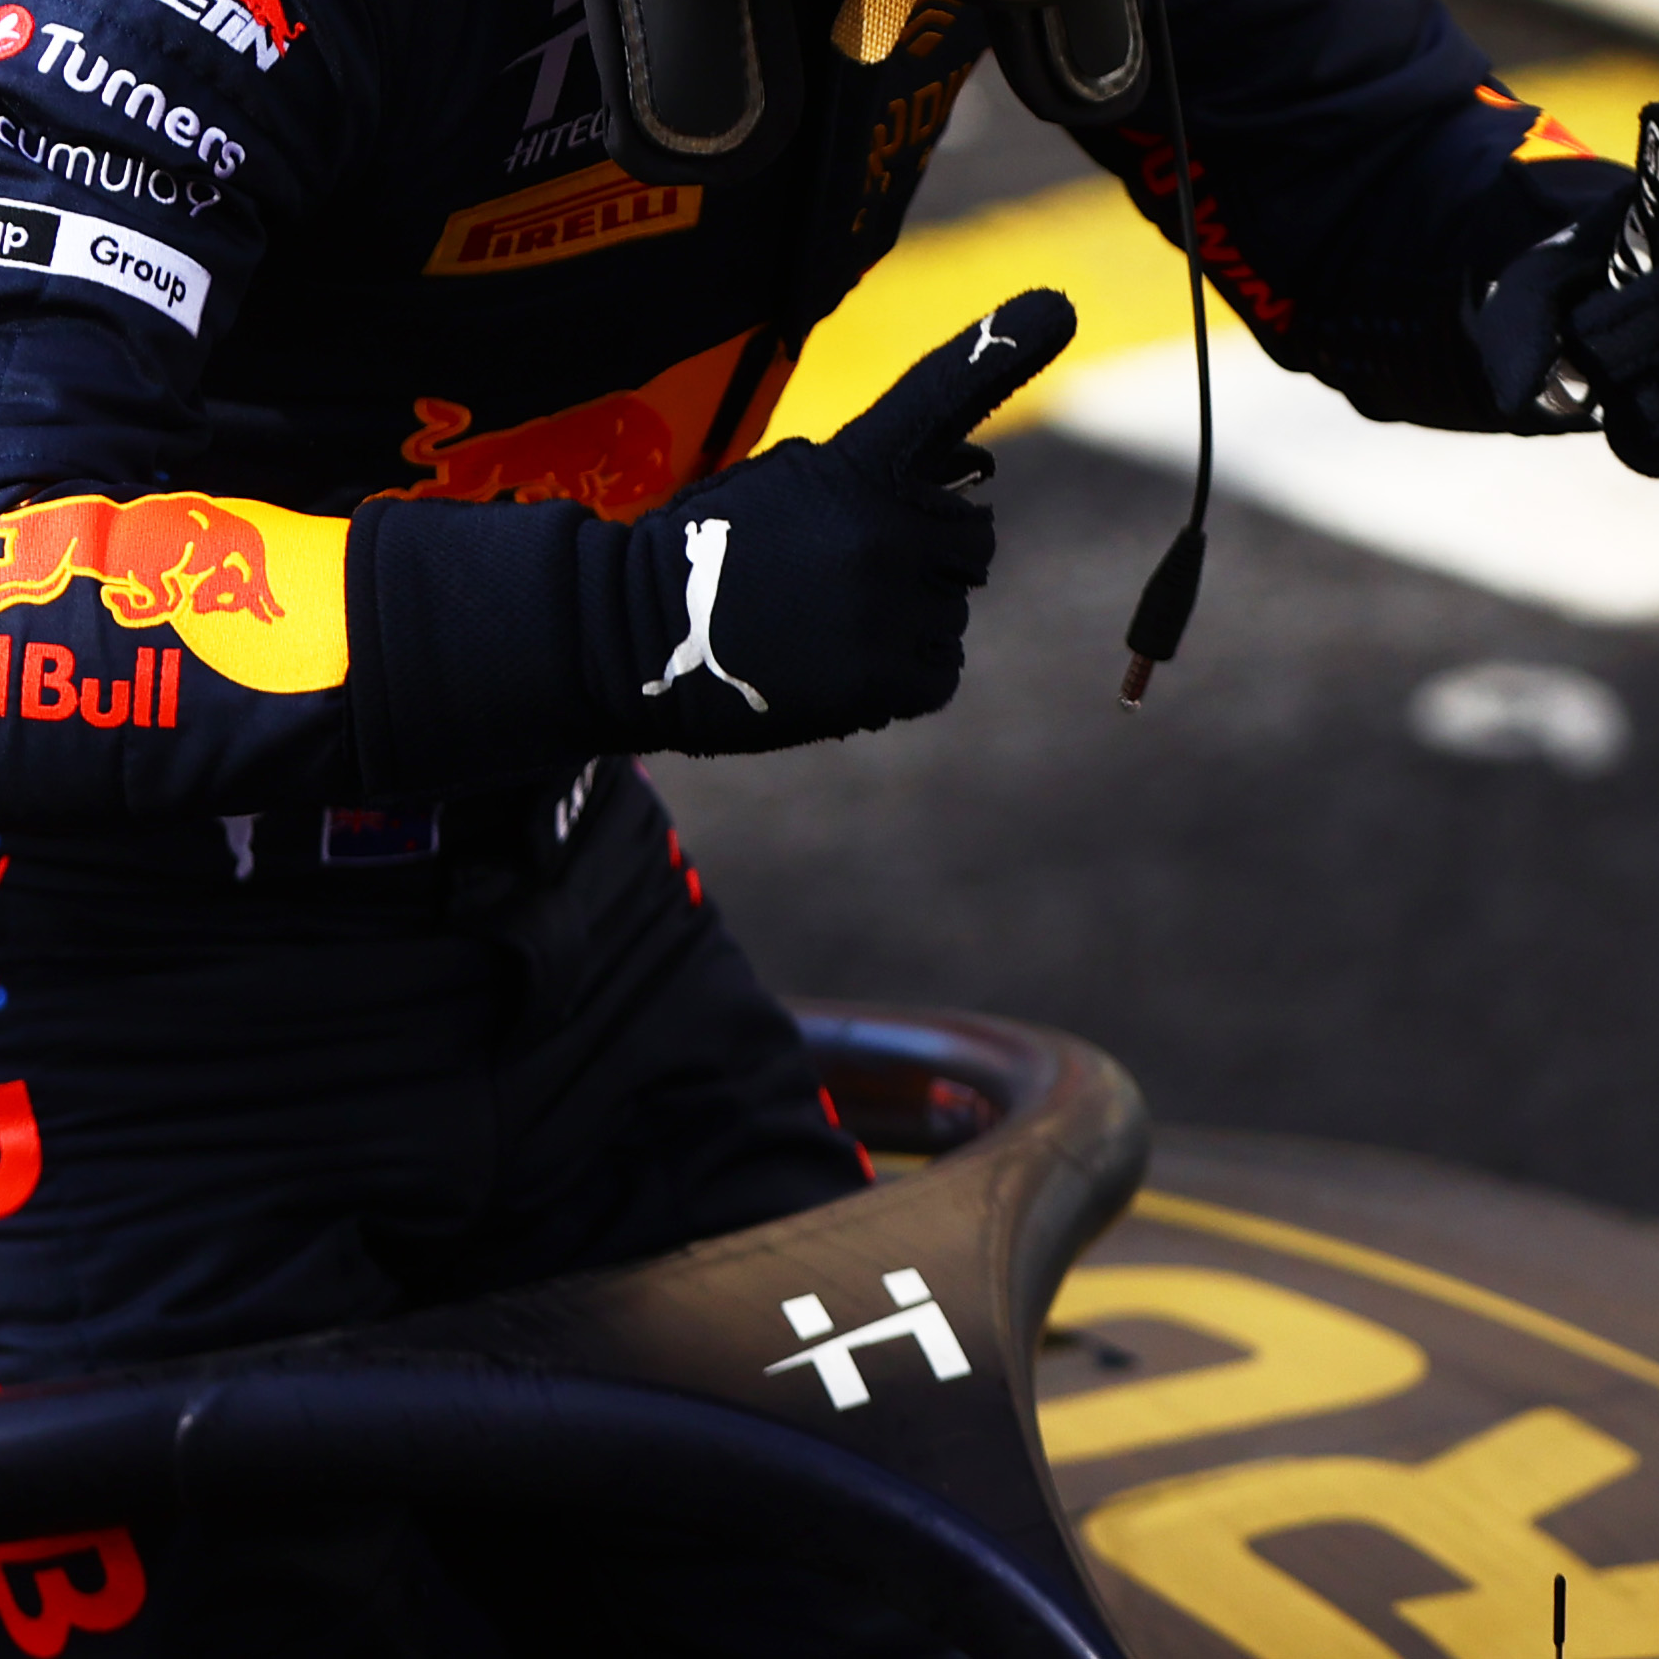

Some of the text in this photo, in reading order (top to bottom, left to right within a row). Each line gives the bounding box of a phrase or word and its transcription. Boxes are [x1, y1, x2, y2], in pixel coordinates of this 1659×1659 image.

[36, 22, 246, 179] Turners
[502, 107, 603, 174] HITEC
[458, 179, 677, 262] PIRELLI
[88, 235, 188, 308] Group
[20, 641, 182, 730] Bull
